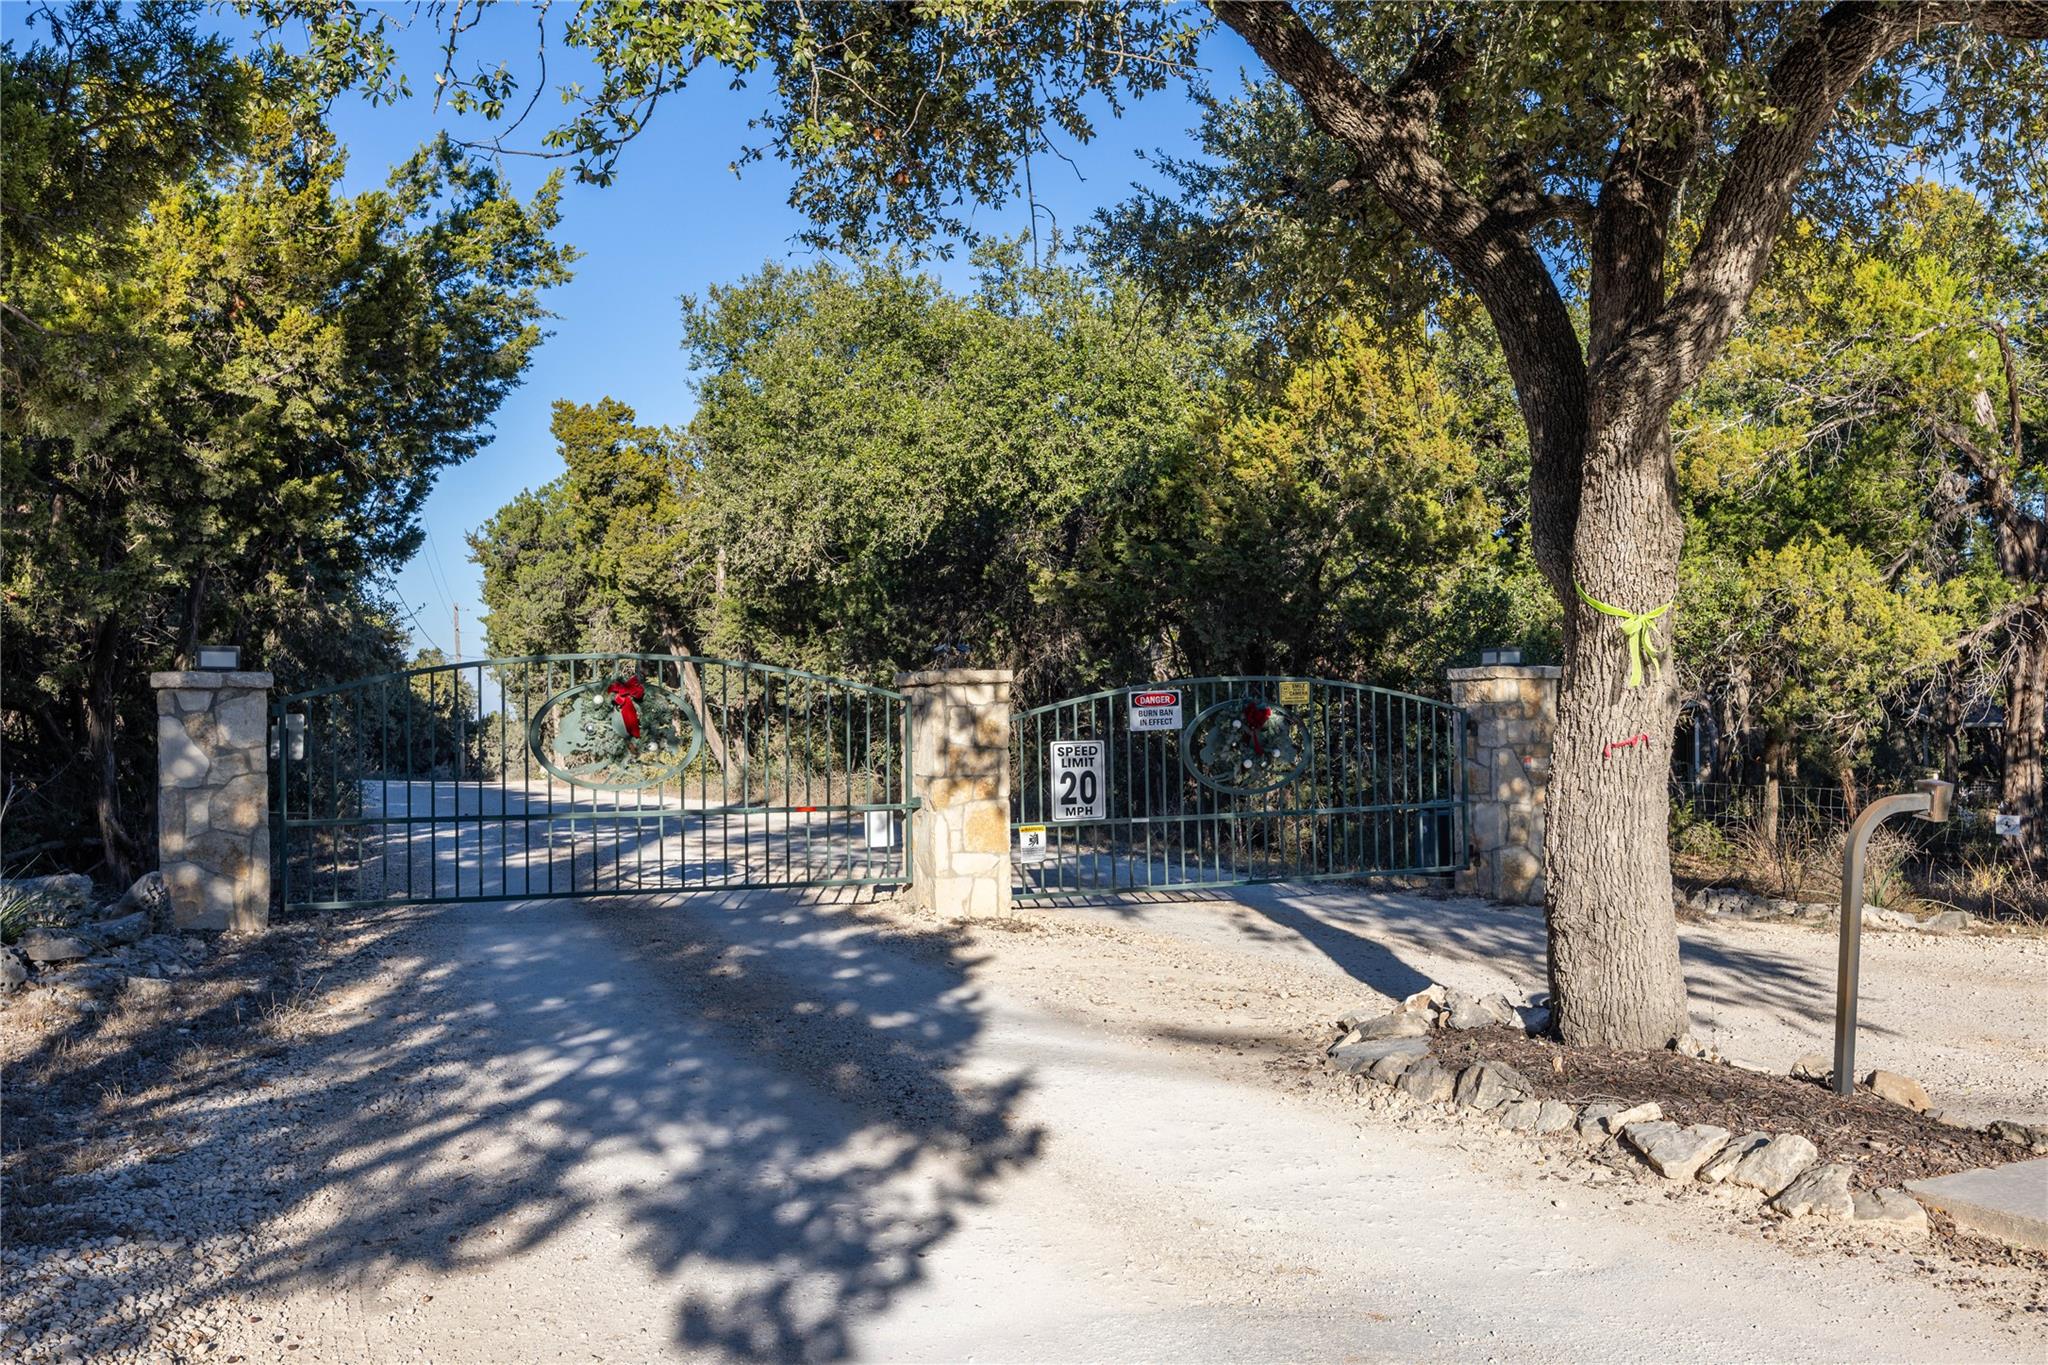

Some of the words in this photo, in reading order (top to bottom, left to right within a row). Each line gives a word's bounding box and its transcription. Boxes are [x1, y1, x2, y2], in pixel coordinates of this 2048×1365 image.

[1140, 696, 1171, 704] DANGER
[1057, 746, 1098, 757] SPEED
[1061, 758, 1095, 768] LIMIT
[1060, 770, 1097, 805] 20
[1065, 806, 1093, 816] MPH
